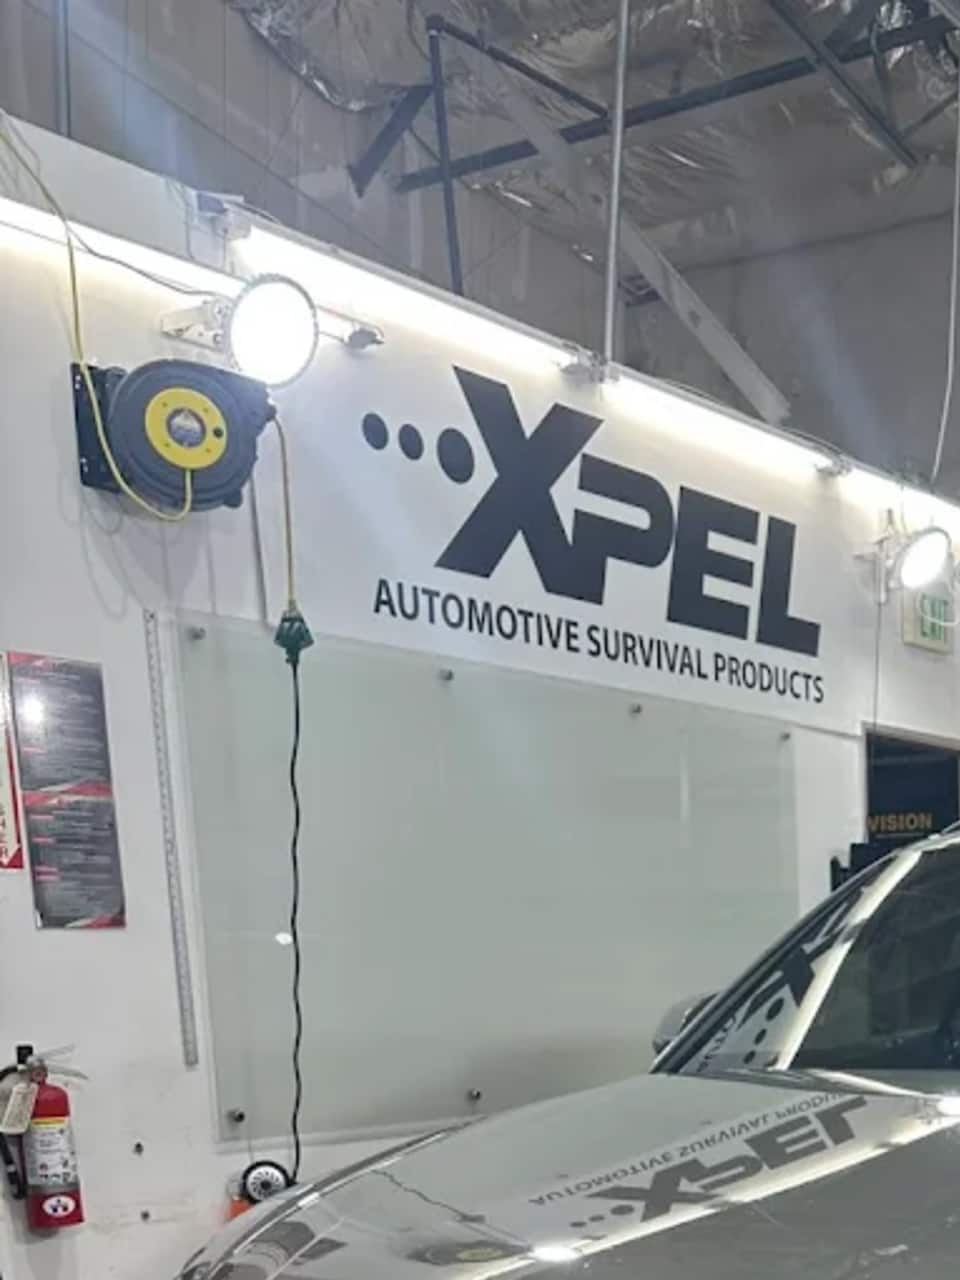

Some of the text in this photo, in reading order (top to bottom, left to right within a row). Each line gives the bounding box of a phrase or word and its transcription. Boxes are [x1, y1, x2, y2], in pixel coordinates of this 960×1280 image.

[434, 365, 822, 657] XPEL
[373, 578, 824, 703] AUTOMOTIVE SURVIVAL PRODUCTS
